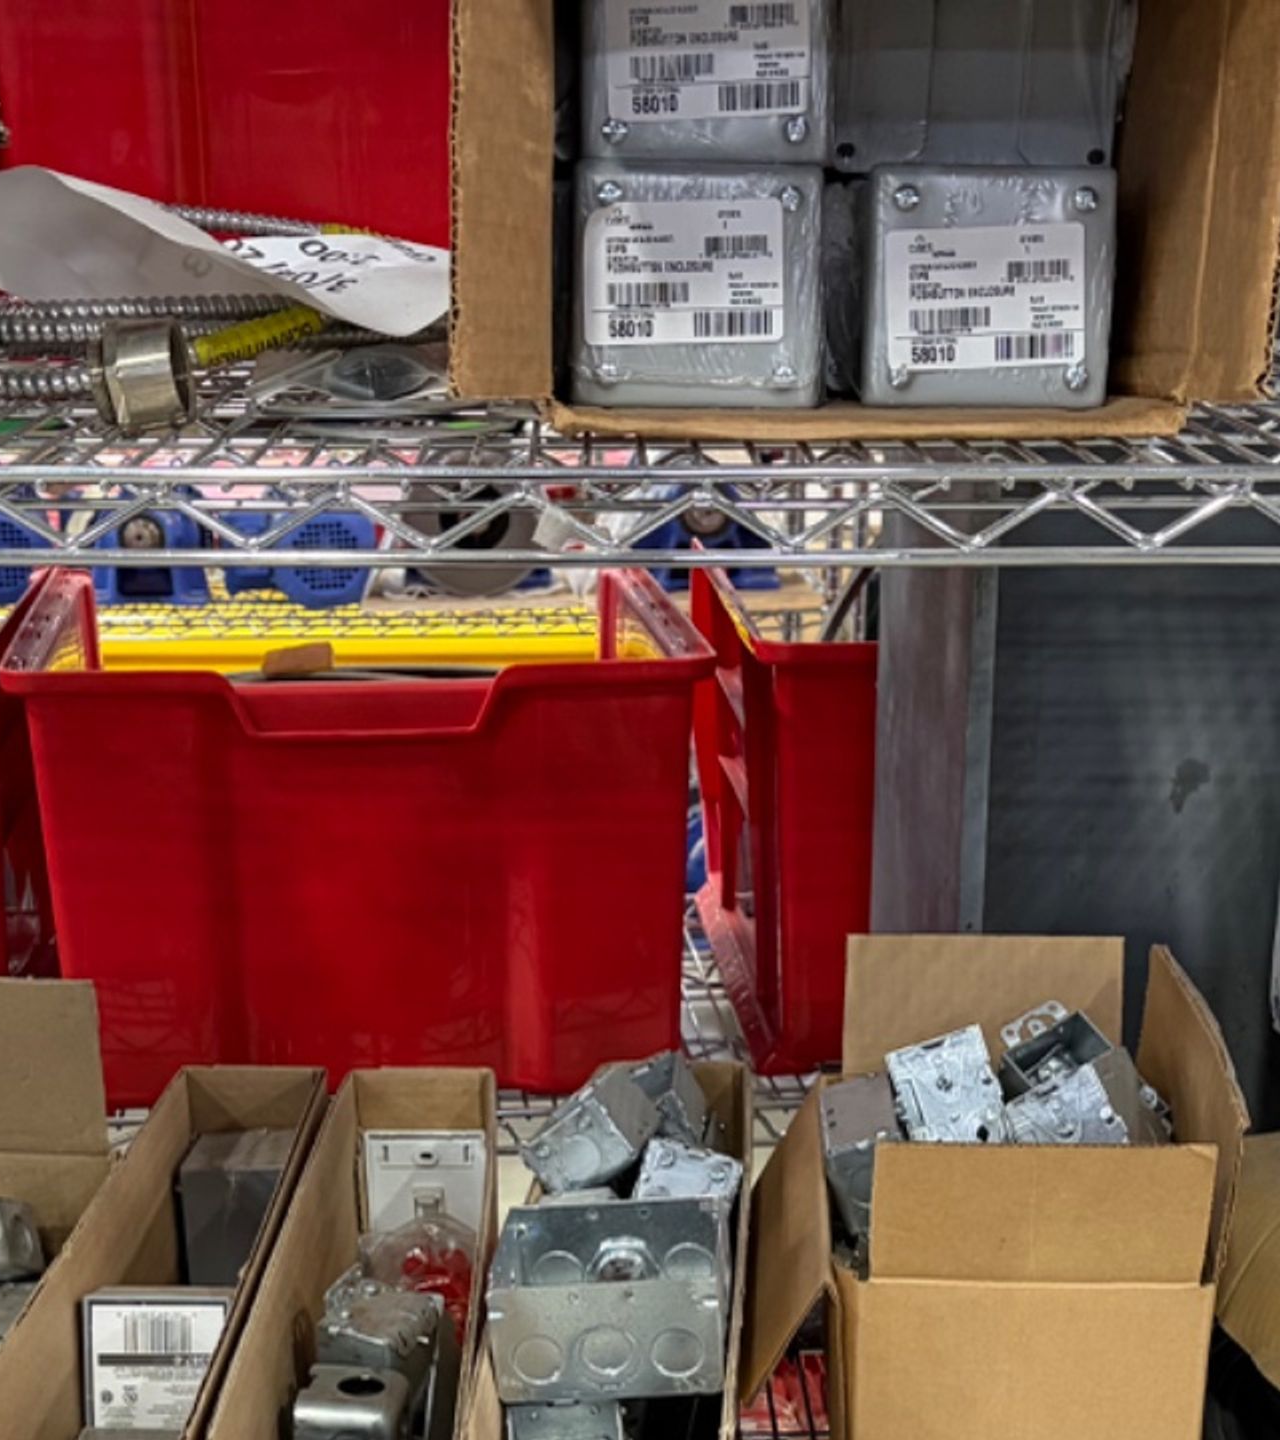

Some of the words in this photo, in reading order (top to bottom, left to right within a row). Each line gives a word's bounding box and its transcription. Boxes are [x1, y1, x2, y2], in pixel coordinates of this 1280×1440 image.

[631, 94, 680, 115] 58010
[608, 320, 654, 338] 58010
[911, 344, 956, 364] 58010
